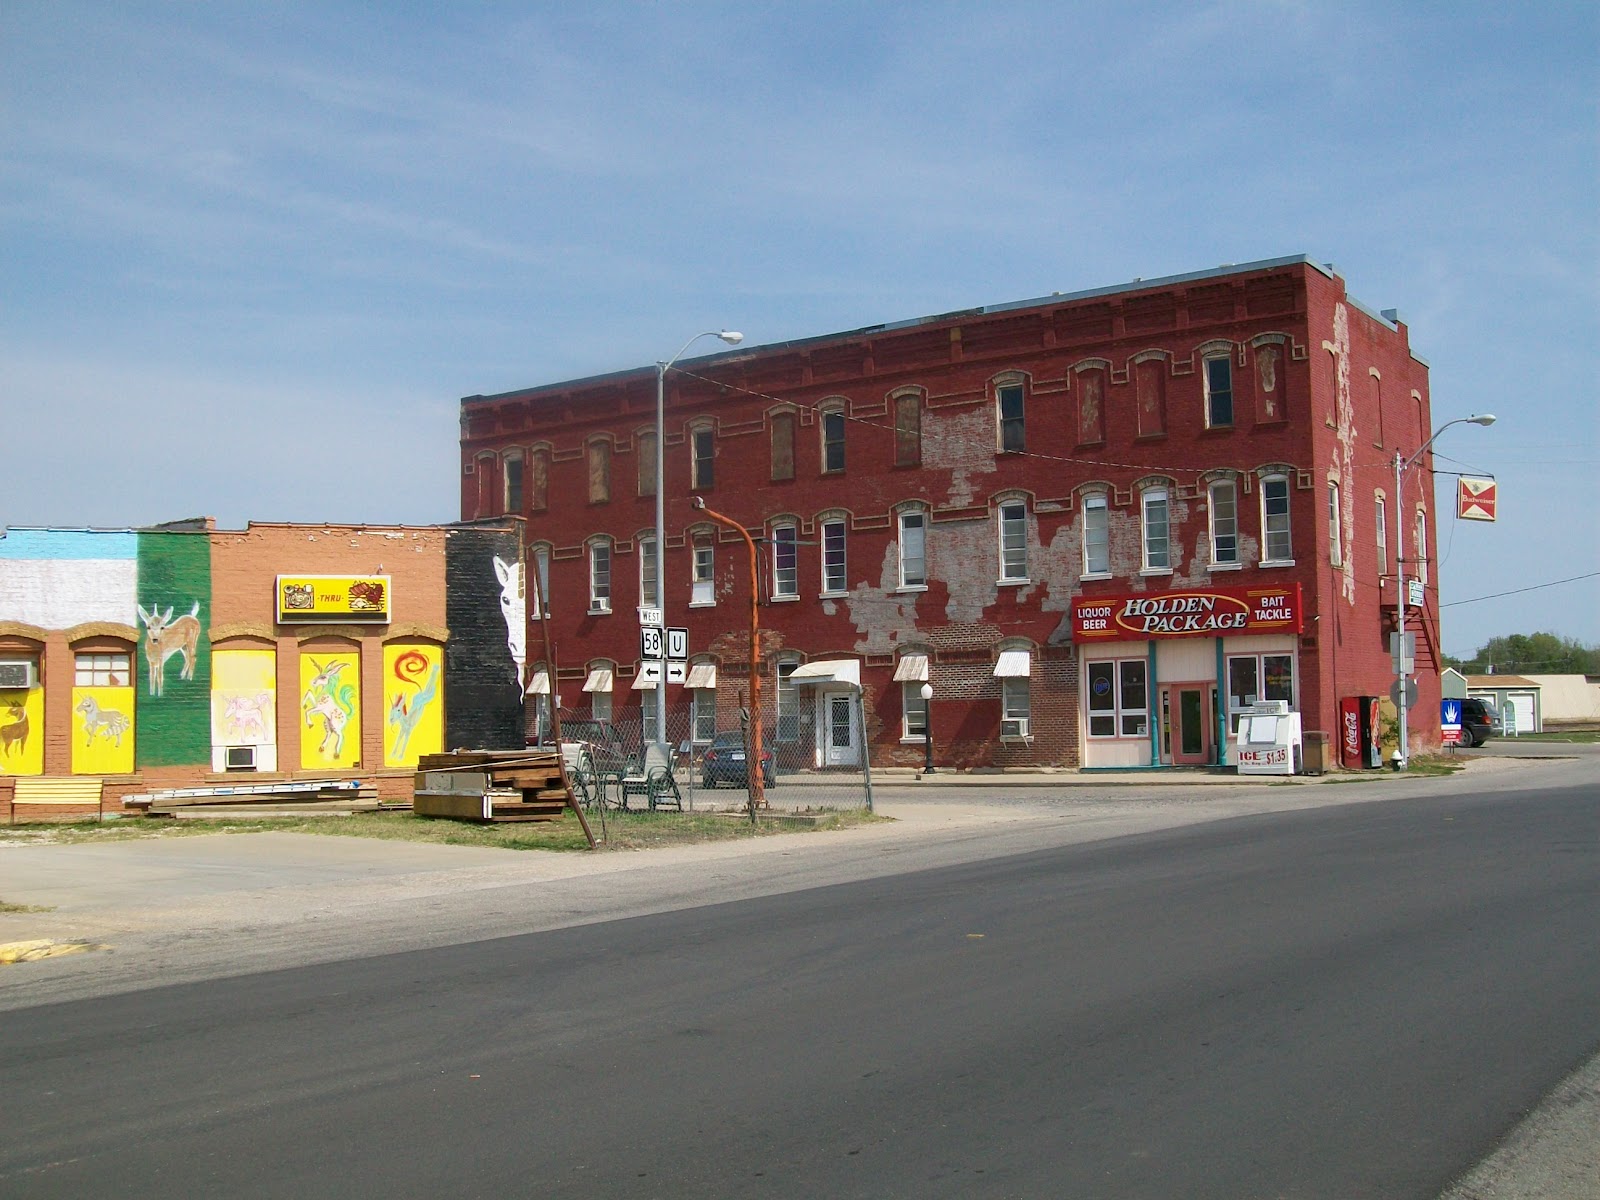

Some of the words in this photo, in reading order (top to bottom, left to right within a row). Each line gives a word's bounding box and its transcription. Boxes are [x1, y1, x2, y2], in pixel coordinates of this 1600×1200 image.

[1462, 494, 1495, 505] Budweiser
[1124, 596, 1217, 617] HOLDEN
[1261, 596, 1285, 608] BAIT
[642, 610, 660, 622] WEST
[1077, 606, 1112, 619] LIQUOR
[1254, 608, 1292, 621] TACKLE
[1082, 618, 1107, 630] BEER
[1141, 612, 1249, 633] PACKAGE
[645, 633, 659, 651] 58
[673, 635, 682, 652] U
[1239, 751, 1261, 761] ICE
[1266, 749, 1286, 765] $1.35
